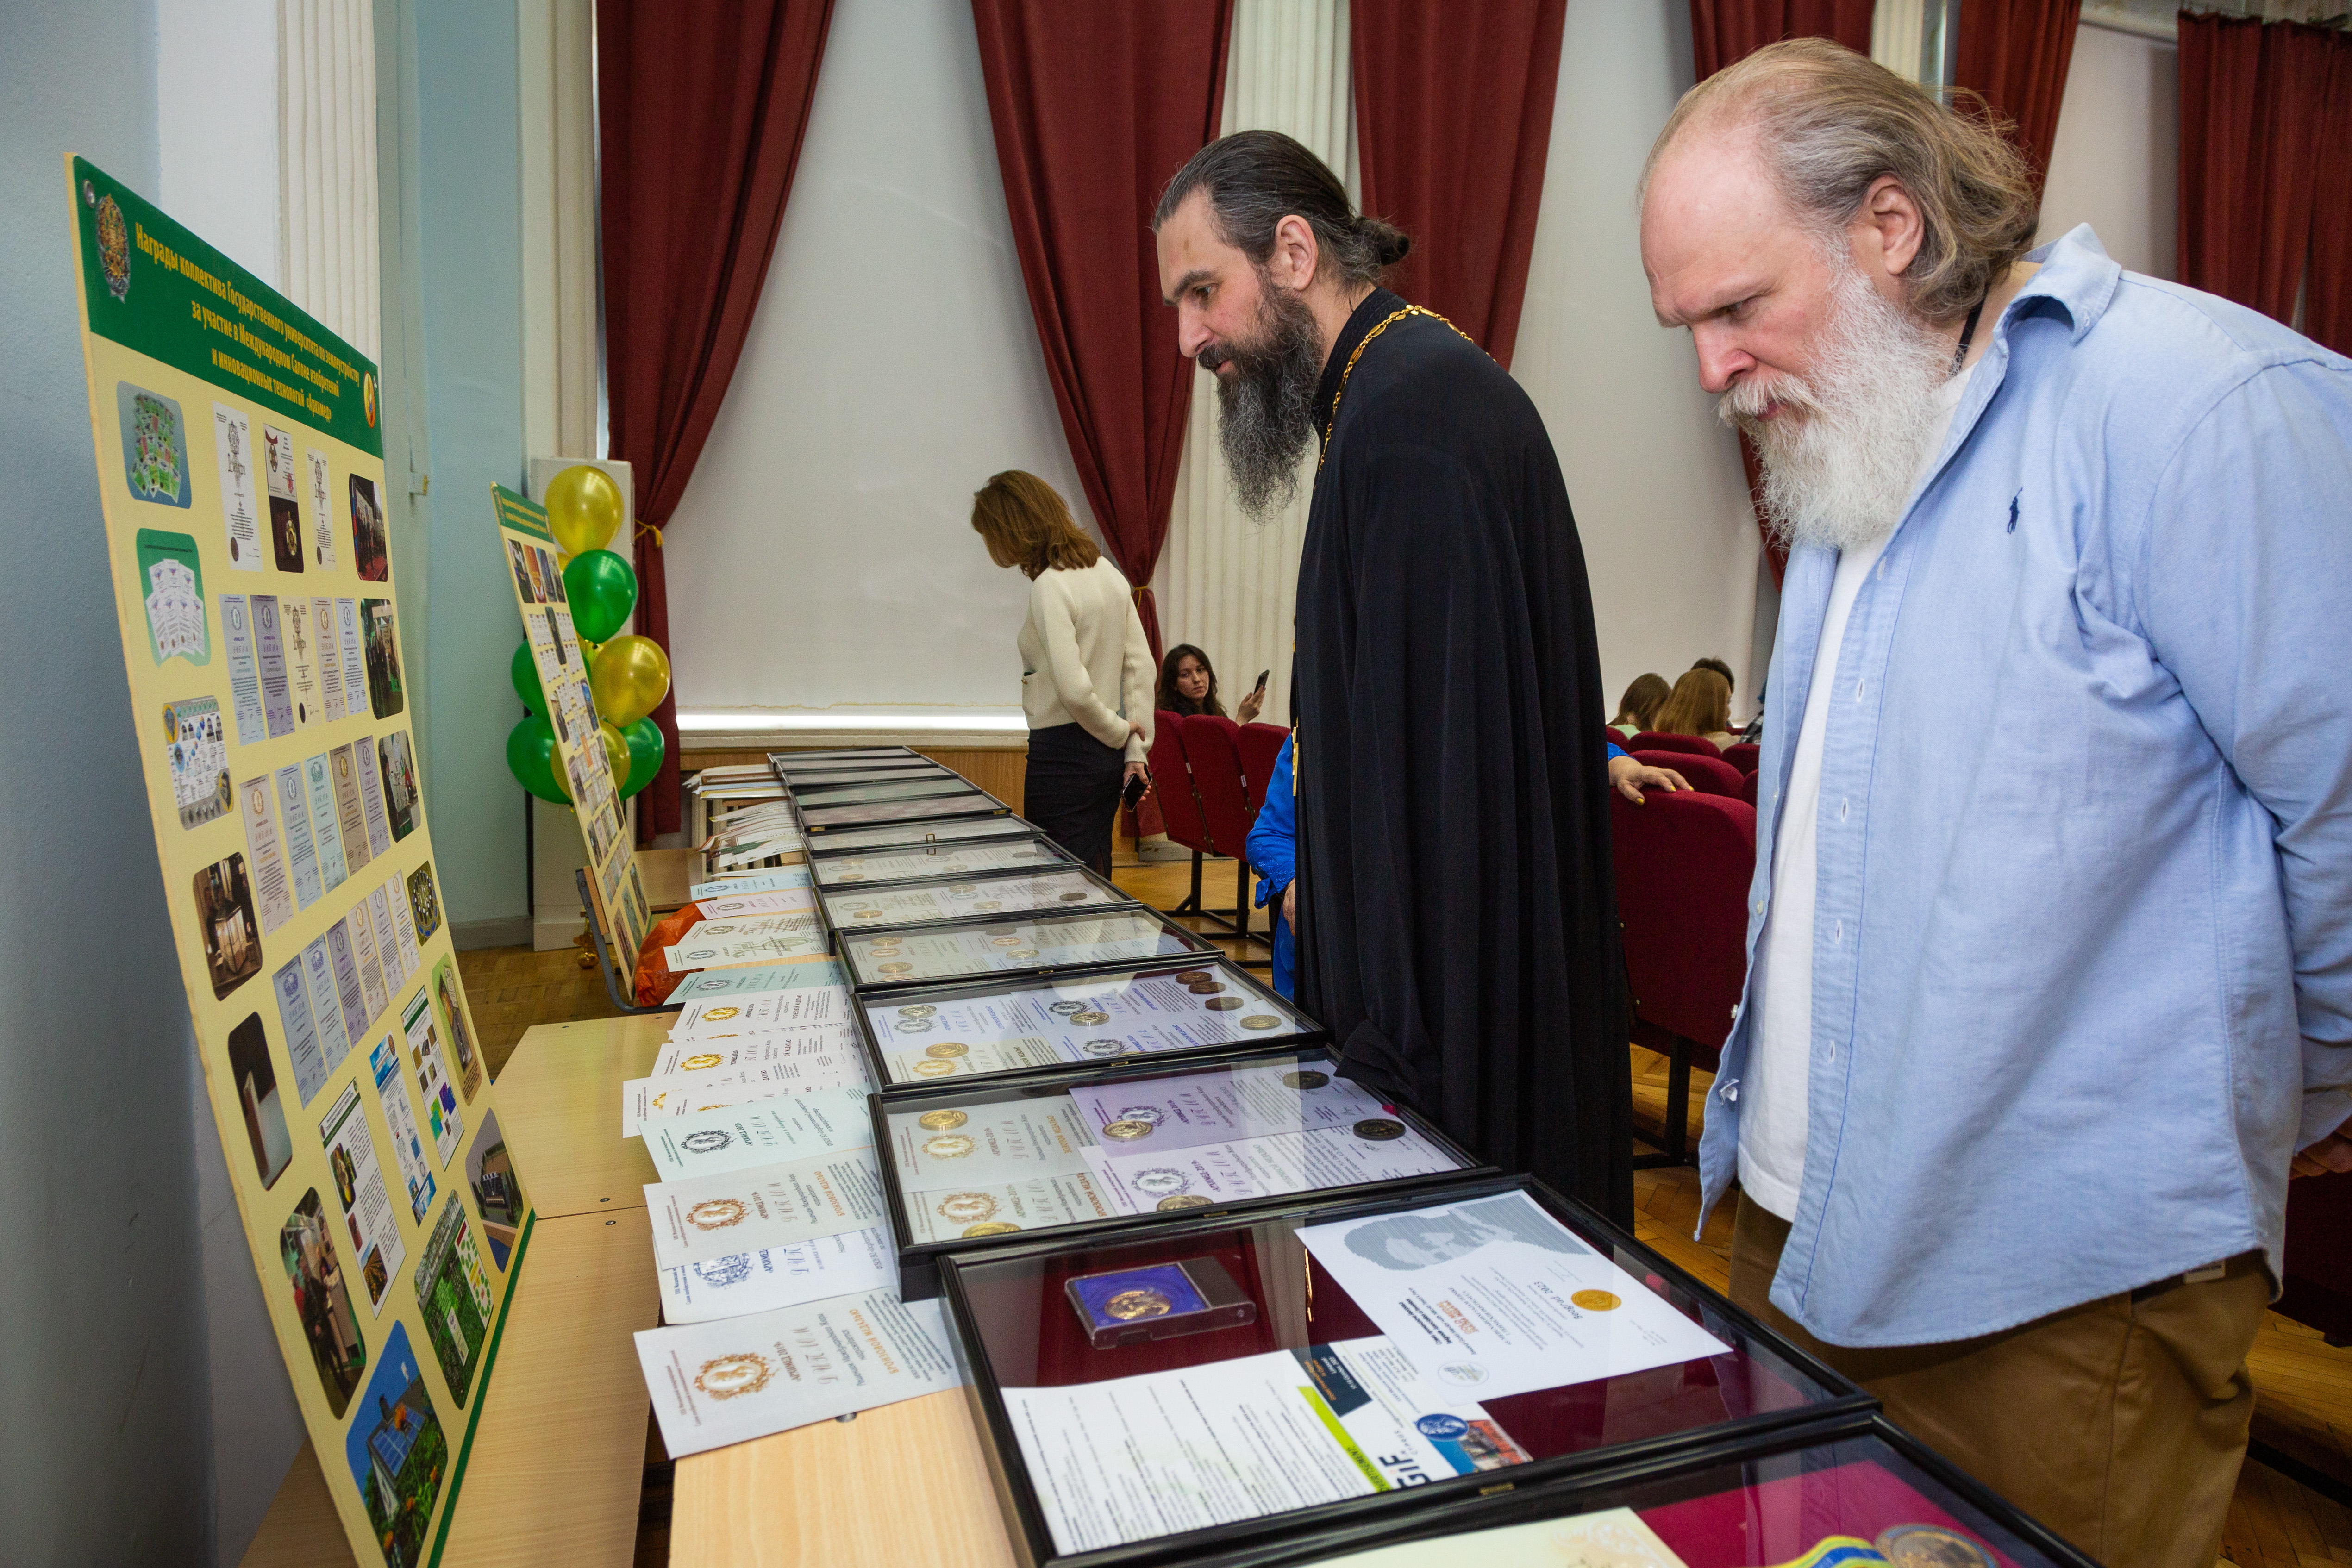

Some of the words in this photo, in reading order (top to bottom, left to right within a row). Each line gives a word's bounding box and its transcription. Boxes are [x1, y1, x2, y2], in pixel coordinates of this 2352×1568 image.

[135, 224, 179, 275] Награды
[179, 256, 226, 300] коллектива
[227, 284, 284, 337] Государственного
[283, 323, 319, 359] университета
[319, 346, 325, 361] по
[324, 350, 361, 385] землеустройству
[191, 300, 202, 322] за
[202, 306, 233, 341] участие
[232, 324, 238, 342] в
[239, 325, 291, 373] Международном
[290, 354, 310, 381] Салоне
[309, 366, 340, 400] изобретений
[211, 347, 218, 366] и
[218, 350, 273, 395] инновационных
[272, 376, 305, 408] технологий
[1045, 1114, 1063, 1134] МЕДАЛЬЮ
[1171, 1108, 1191, 1124] «АРХИМЕД
[733, 1122, 744, 1131] 2020»
[738, 1131, 754, 1147] «АРХИМЕД
[1055, 1134, 1073, 1154] ЗОЛОТОЙ
[1251, 1144, 1277, 1164] МЕДАЛЬЮ
[813, 1170, 832, 1190] МЕДАЛЬЮ
[1186, 1159, 1223, 1193] «АРХИМЕД-2019»
[1268, 1163, 1301, 1189] СЕРЕБРЯНОЙ
[750, 1191, 762, 1202] 2019»
[824, 1190, 846, 1217] БРОНЗОВОЙ
[1084, 1190, 1108, 1217] БРОНЗОВОЙ
[754, 1201, 769, 1221] «АРХИМЕД
[1531, 1281, 1555, 1294] 2023
[1434, 1301, 1457, 1319] MEDAL
[1549, 1295, 1587, 1320] Beograd
[846, 1308, 875, 1337] МЕДАЛЬЮ
[1440, 1322, 1457, 1334] Medal
[1451, 1319, 1473, 1335] GOLD
[1451, 1333, 1466, 1343] Gold
[771, 1341, 788, 1356] 2019»
[865, 1337, 900, 1374] БРОНЗОВОЙ
[1460, 1342, 1478, 1356] Award
[779, 1355, 801, 1382] «АРХИМЕД
[1391, 1429, 1420, 1456] CYPRUS
